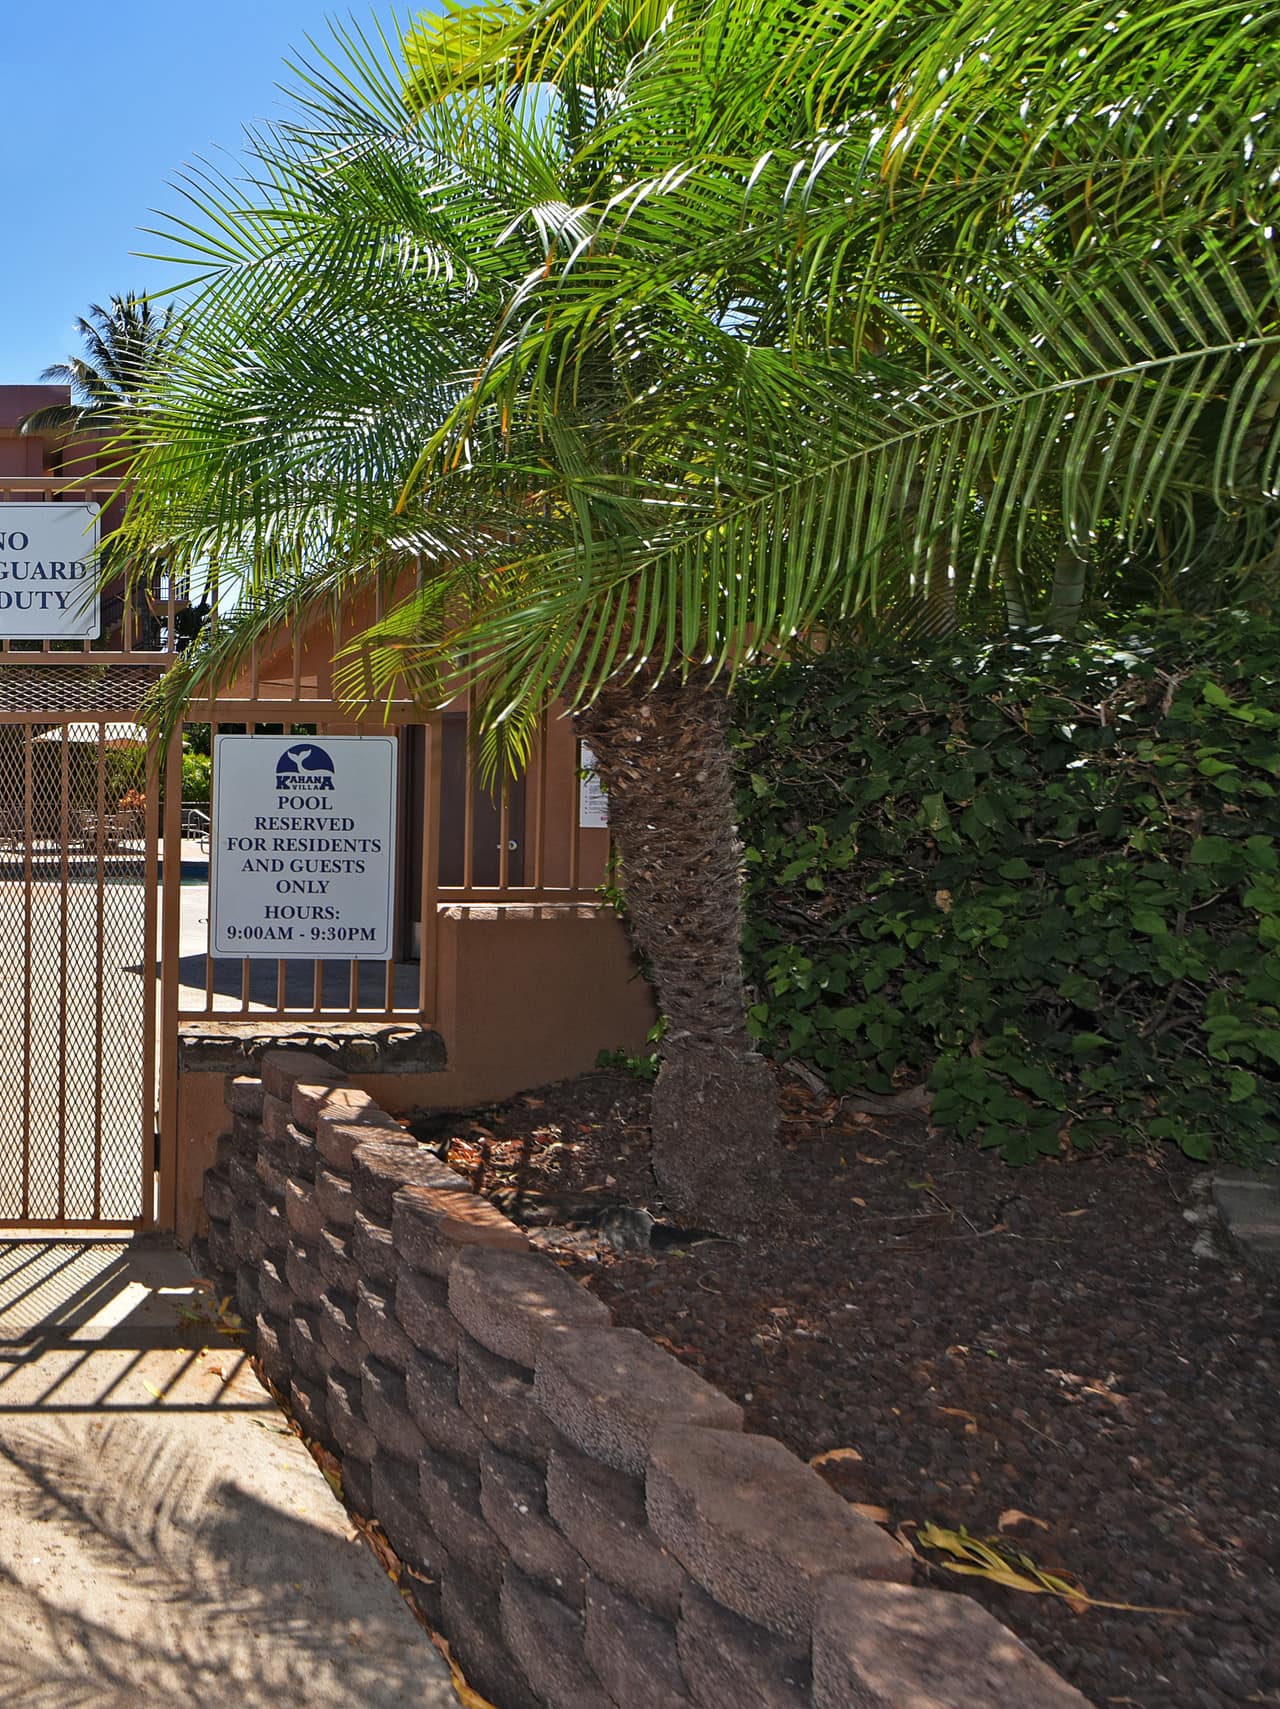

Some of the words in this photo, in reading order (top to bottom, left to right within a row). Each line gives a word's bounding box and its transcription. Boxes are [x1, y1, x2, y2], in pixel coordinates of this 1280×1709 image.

[276, 775, 335, 790] KAHANA
[278, 796, 333, 810] POOL
[254, 817, 355, 831] RESERVED
[227, 837, 266, 851] FOR
[272, 838, 381, 852] RESIDENTS
[241, 859, 284, 872] AND
[290, 859, 365, 873] GUESTS
[276, 880, 329, 894] ONLY
[264, 906, 340, 920] HOURS:
[227, 926, 293, 940] 9:00AM
[311, 927, 376, 941] 9:30PM
